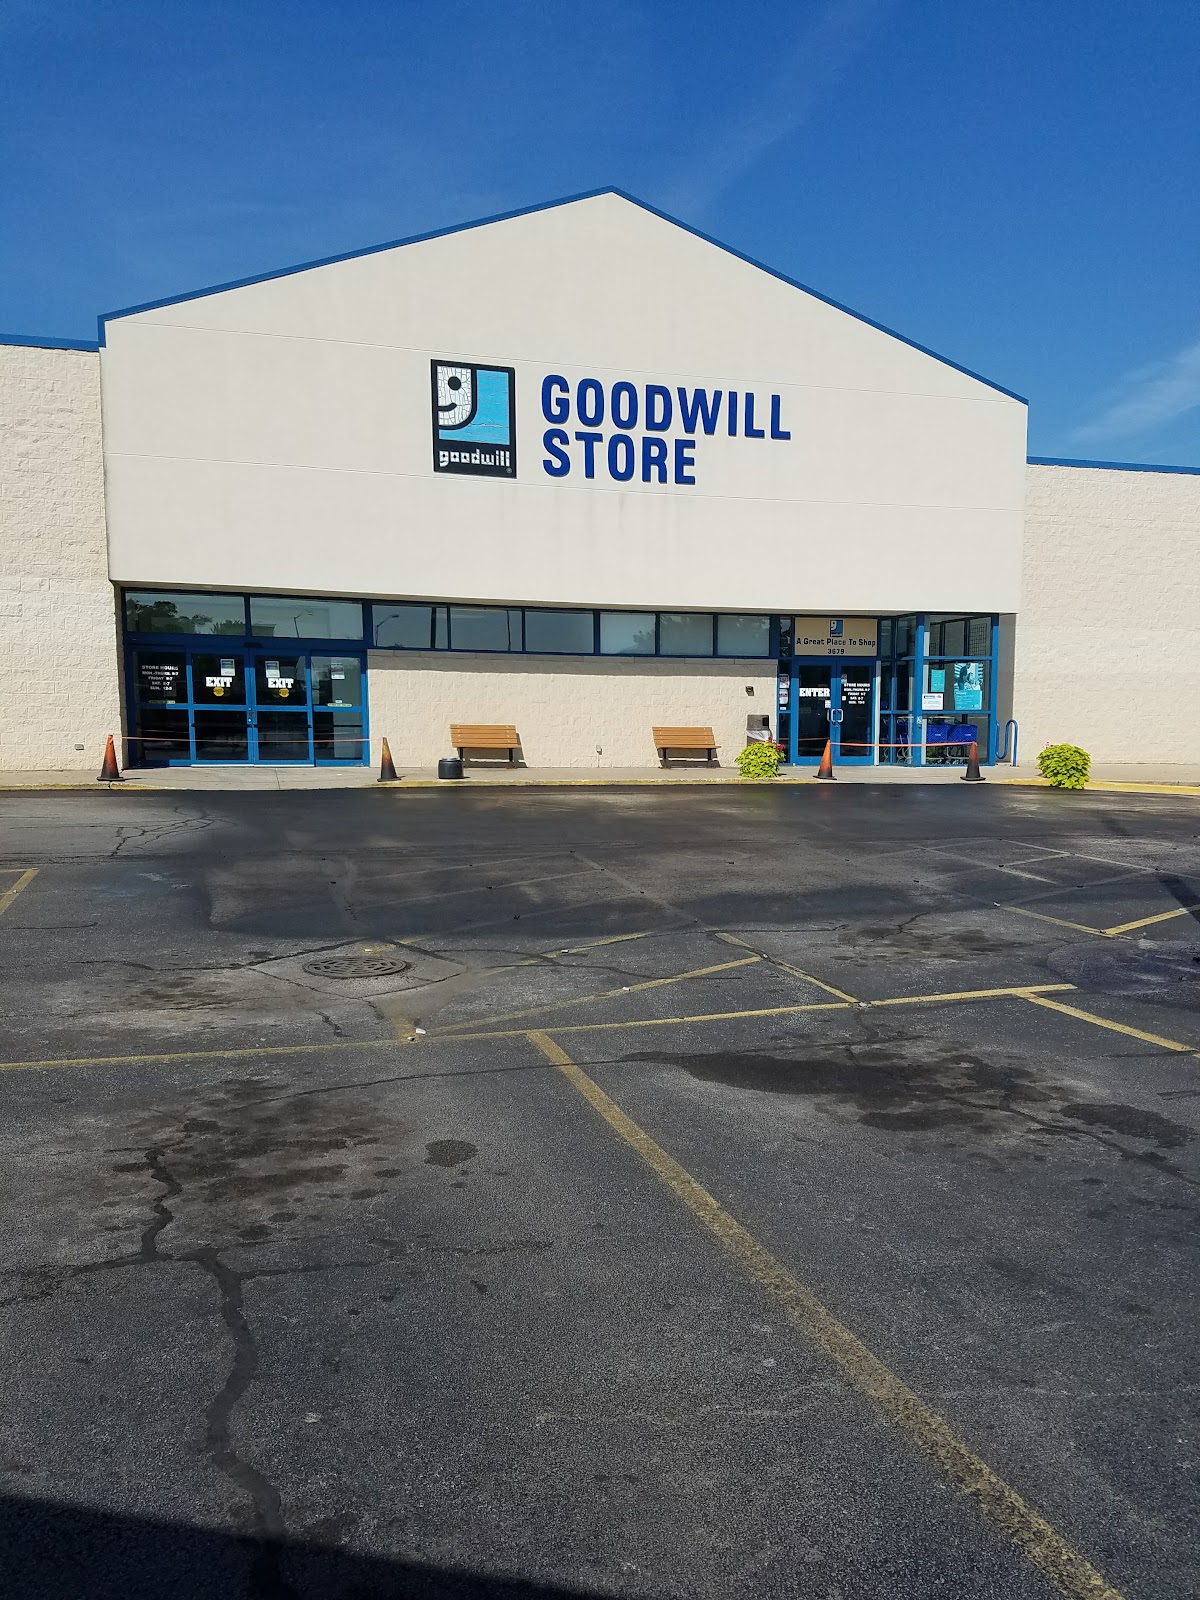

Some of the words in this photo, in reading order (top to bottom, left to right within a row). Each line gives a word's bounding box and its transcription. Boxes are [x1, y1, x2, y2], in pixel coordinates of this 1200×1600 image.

[541, 374, 791, 440] GOODWILL
[439, 448, 511, 468] goodwill
[542, 428, 696, 485] STORE
[803, 638, 825, 646] Great
[826, 638, 847, 646] Place
[848, 638, 857, 646] To
[858, 639, 876, 647] Shop
[205, 676, 232, 687] EXIT
[267, 678, 293, 688] EXIT
[799, 688, 831, 697] ENTER
